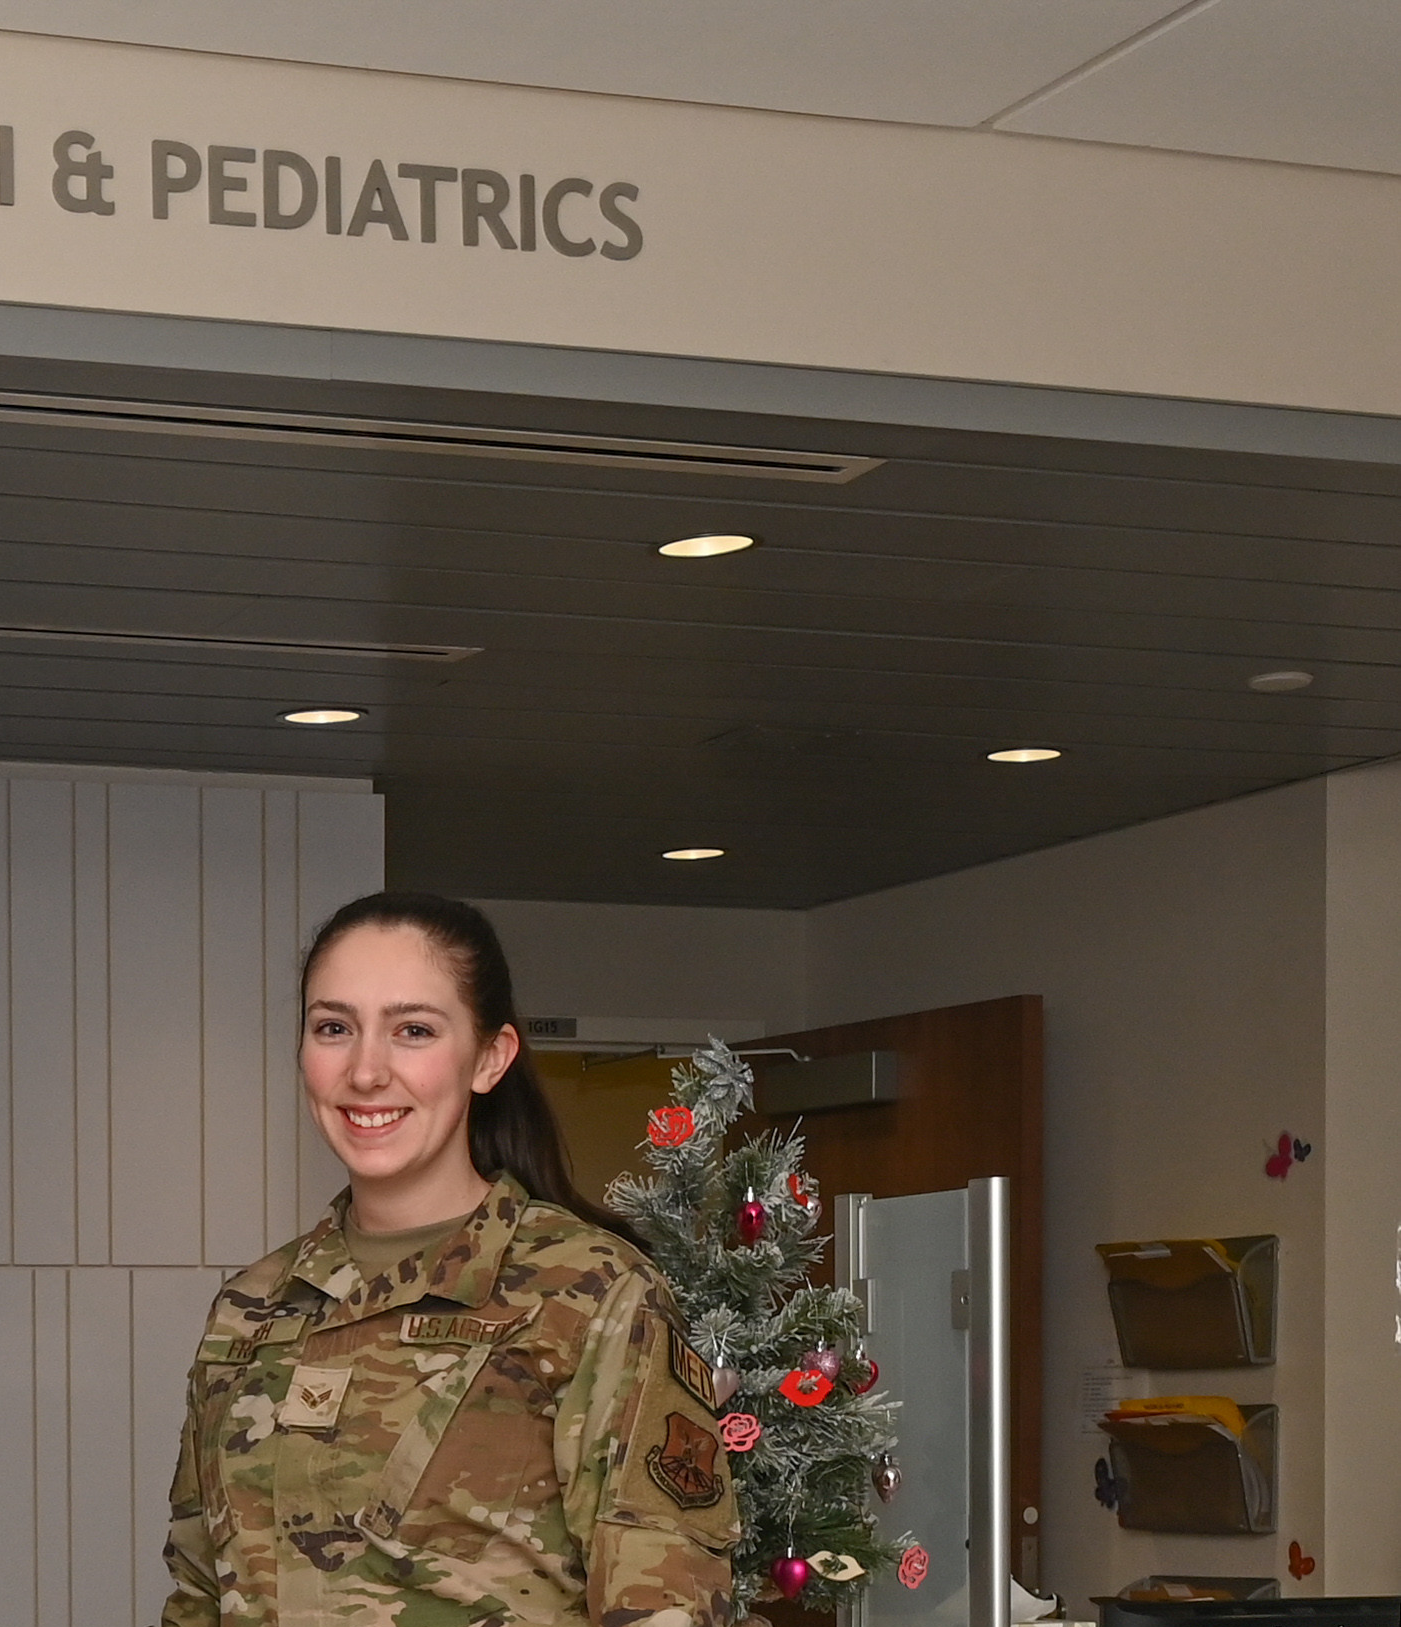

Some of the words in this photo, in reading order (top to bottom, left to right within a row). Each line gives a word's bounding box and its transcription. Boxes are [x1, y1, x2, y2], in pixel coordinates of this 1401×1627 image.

[51, 130, 116, 216] &
[151, 138, 644, 261] PEDIATRICS
[674, 1330, 713, 1403] MED
